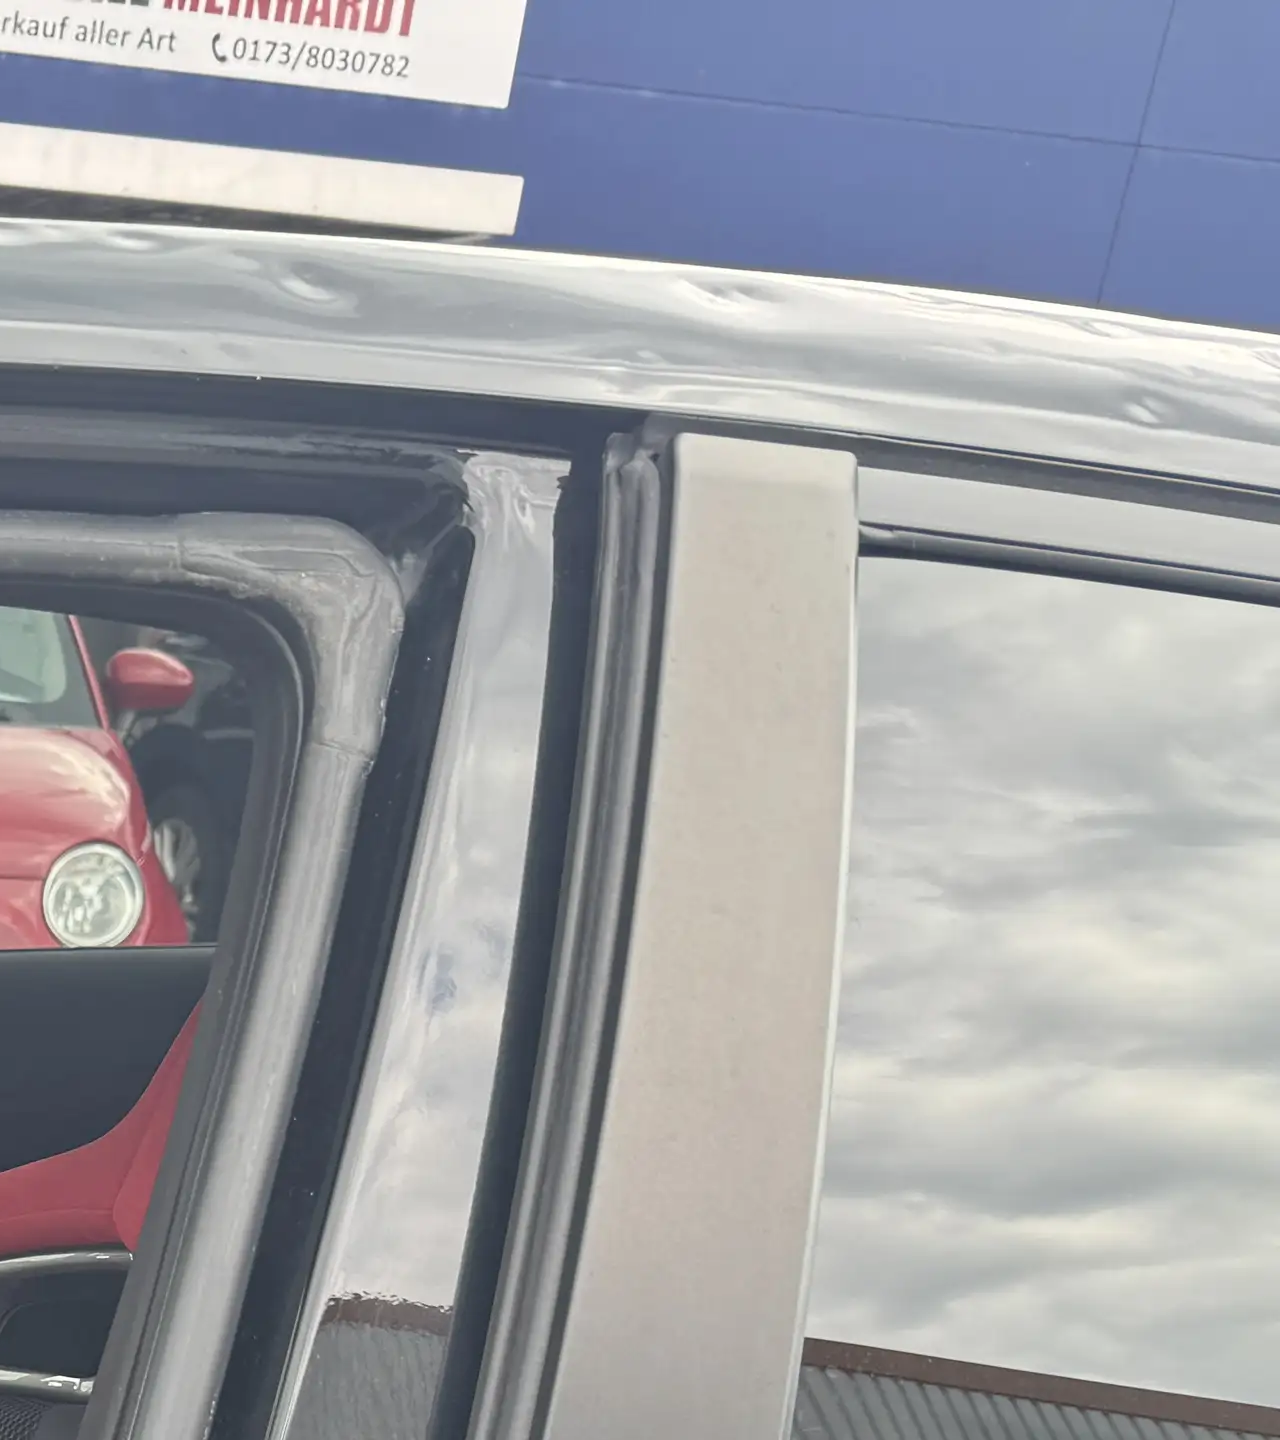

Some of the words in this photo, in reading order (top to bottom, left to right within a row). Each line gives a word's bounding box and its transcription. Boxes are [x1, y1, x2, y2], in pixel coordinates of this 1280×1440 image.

[163, 0, 416, 37] HARDT
[74, 20, 132, 48] aller
[136, 27, 177, 53] Art
[231, 37, 410, 79] 0173/8030782
